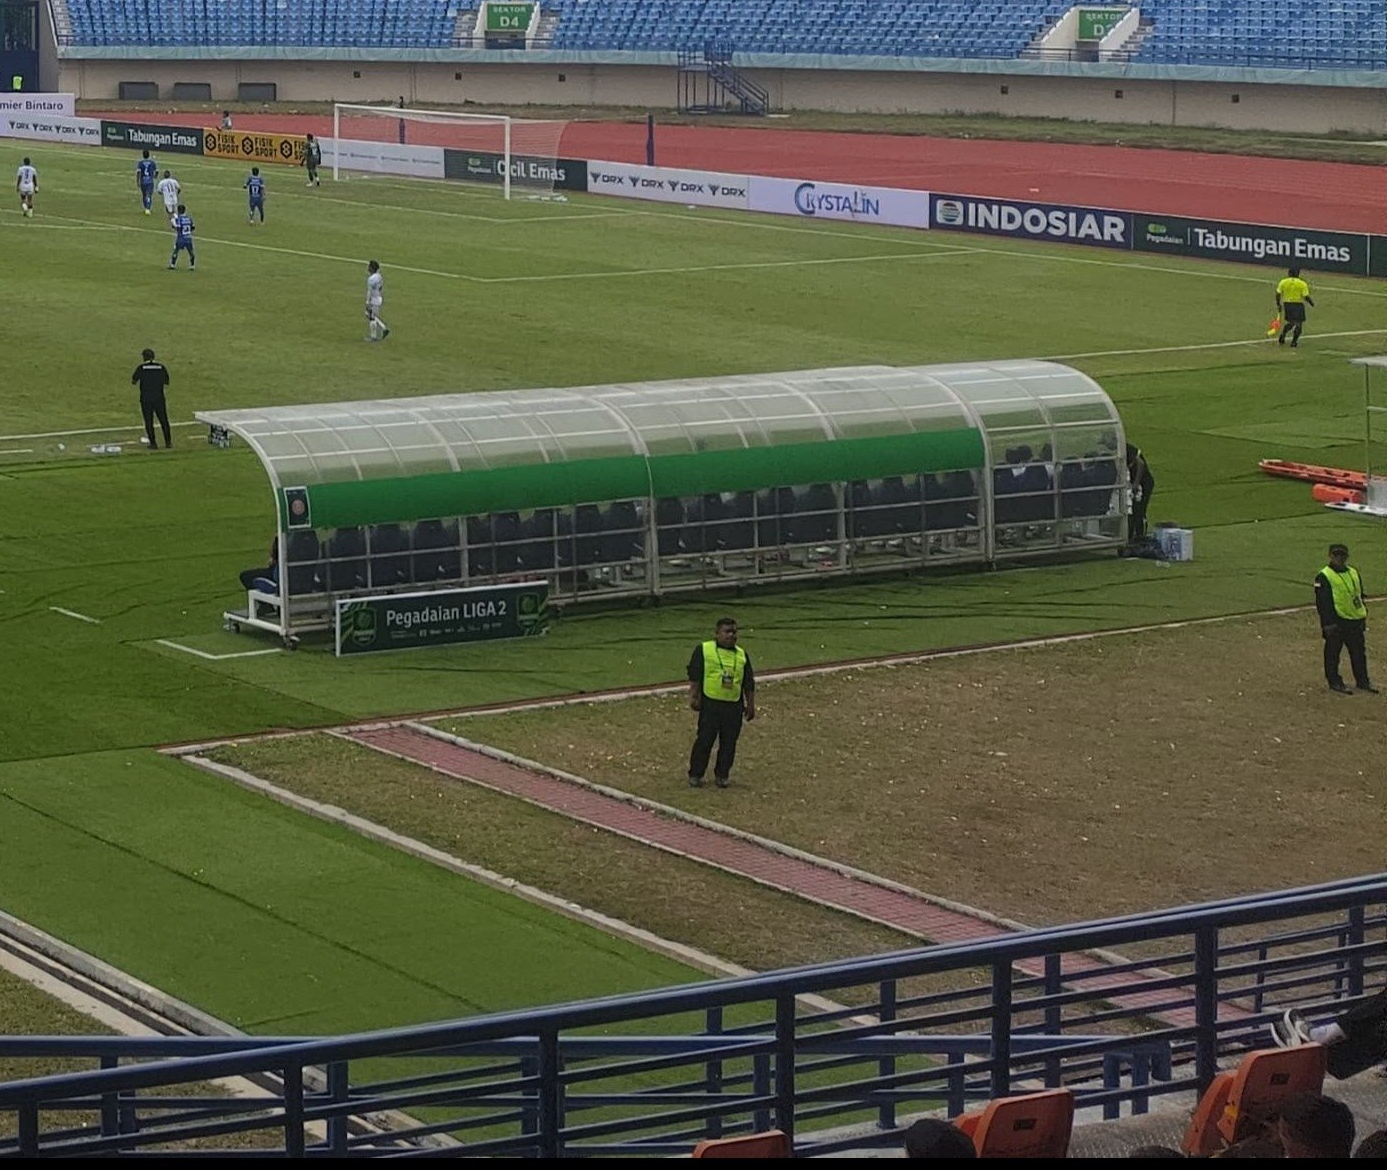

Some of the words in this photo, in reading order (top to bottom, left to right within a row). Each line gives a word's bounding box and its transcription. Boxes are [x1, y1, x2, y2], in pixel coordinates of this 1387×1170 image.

[499, 16, 519, 27] D4
[25, 99, 64, 111] Bintaro
[128, 129, 170, 147] Tabungan
[172, 133, 197, 147] Emas
[218, 133, 236, 144] FISIK
[255, 136, 274, 147] FISIK
[218, 144, 239, 155] SPORT
[255, 147, 277, 158] SPORT
[497, 160, 526, 178] Ccil
[529, 162, 566, 181] Emas
[967, 202, 1125, 243] INDOSIAR
[1193, 228, 1291, 258] Tabungan
[1294, 237, 1351, 262] Emas
[386, 606, 459, 628] Pegadaian
[463, 602, 497, 618] LIGA
[498, 600, 507, 615] 2
